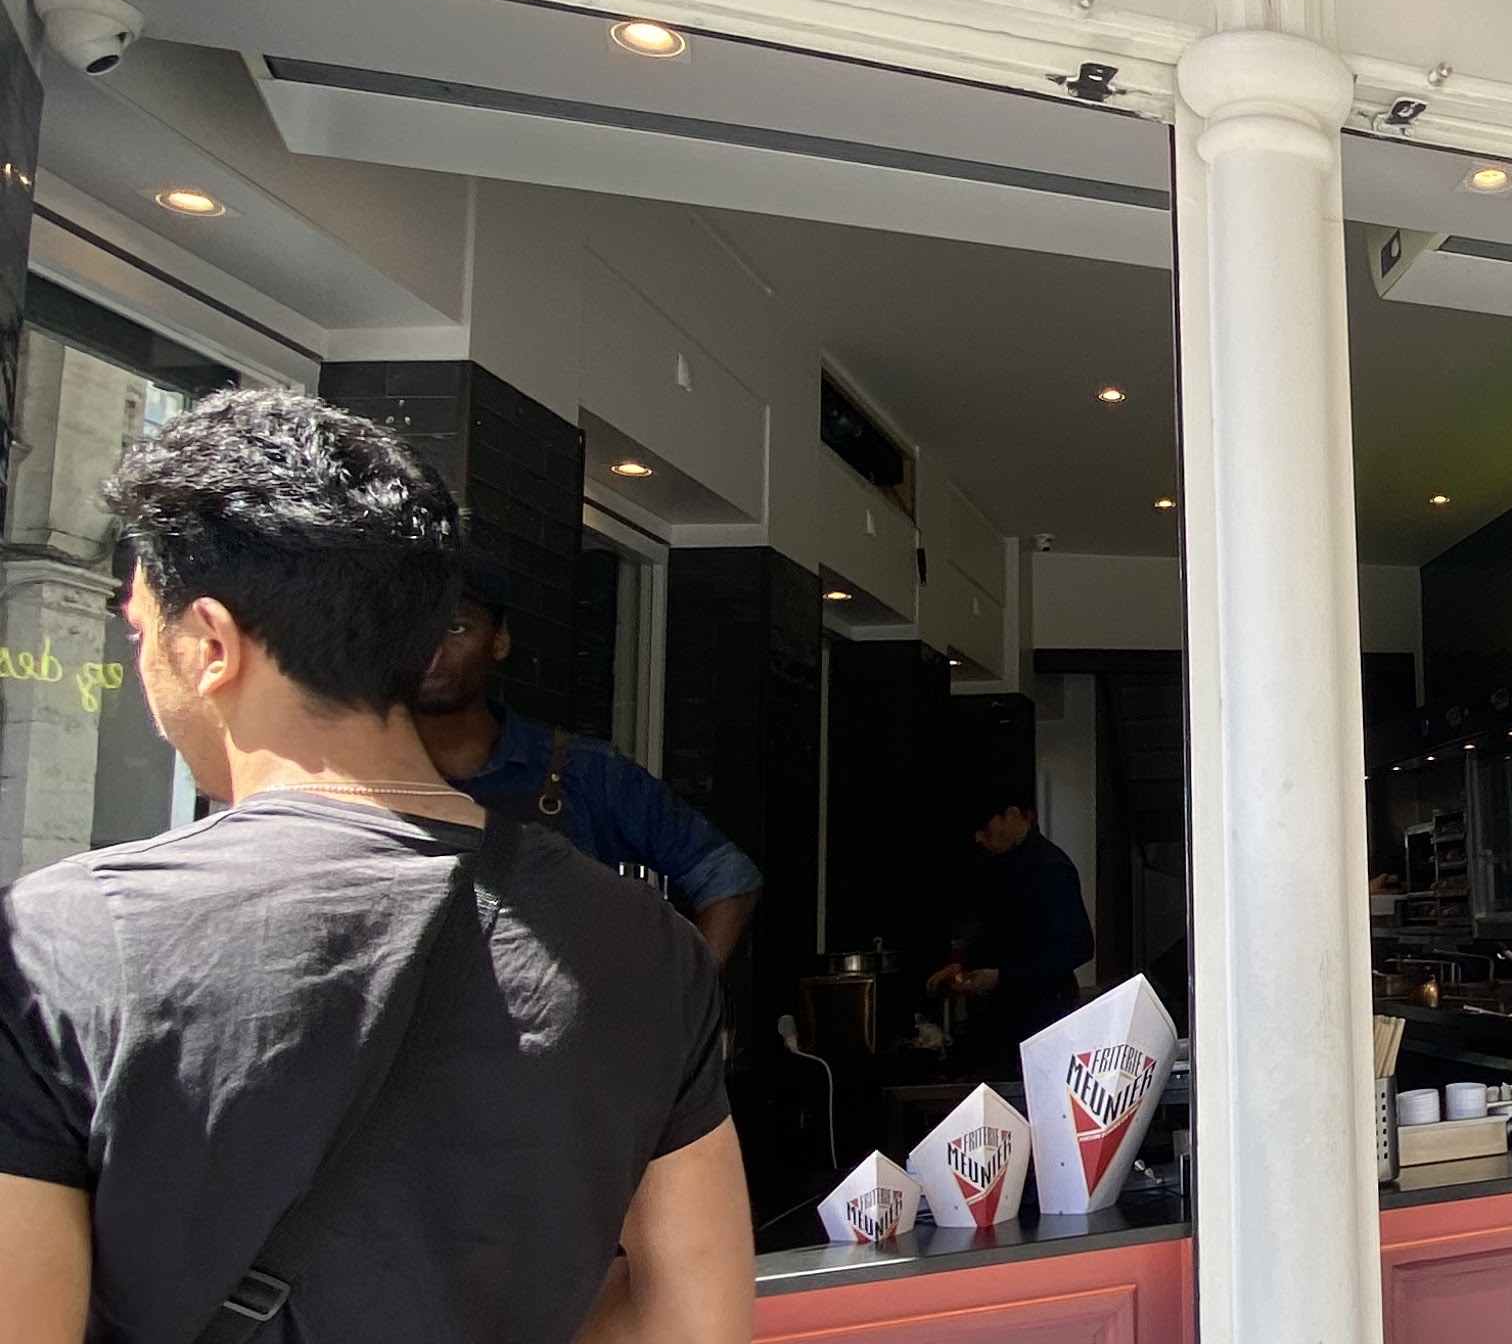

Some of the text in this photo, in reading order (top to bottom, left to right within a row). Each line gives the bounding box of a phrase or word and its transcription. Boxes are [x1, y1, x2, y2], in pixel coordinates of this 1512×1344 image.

[1091, 1043, 1143, 1076] FRITERIE
[1066, 1053, 1157, 1125] MEUNIER
[947, 1131, 1012, 1188] MEUNIER
